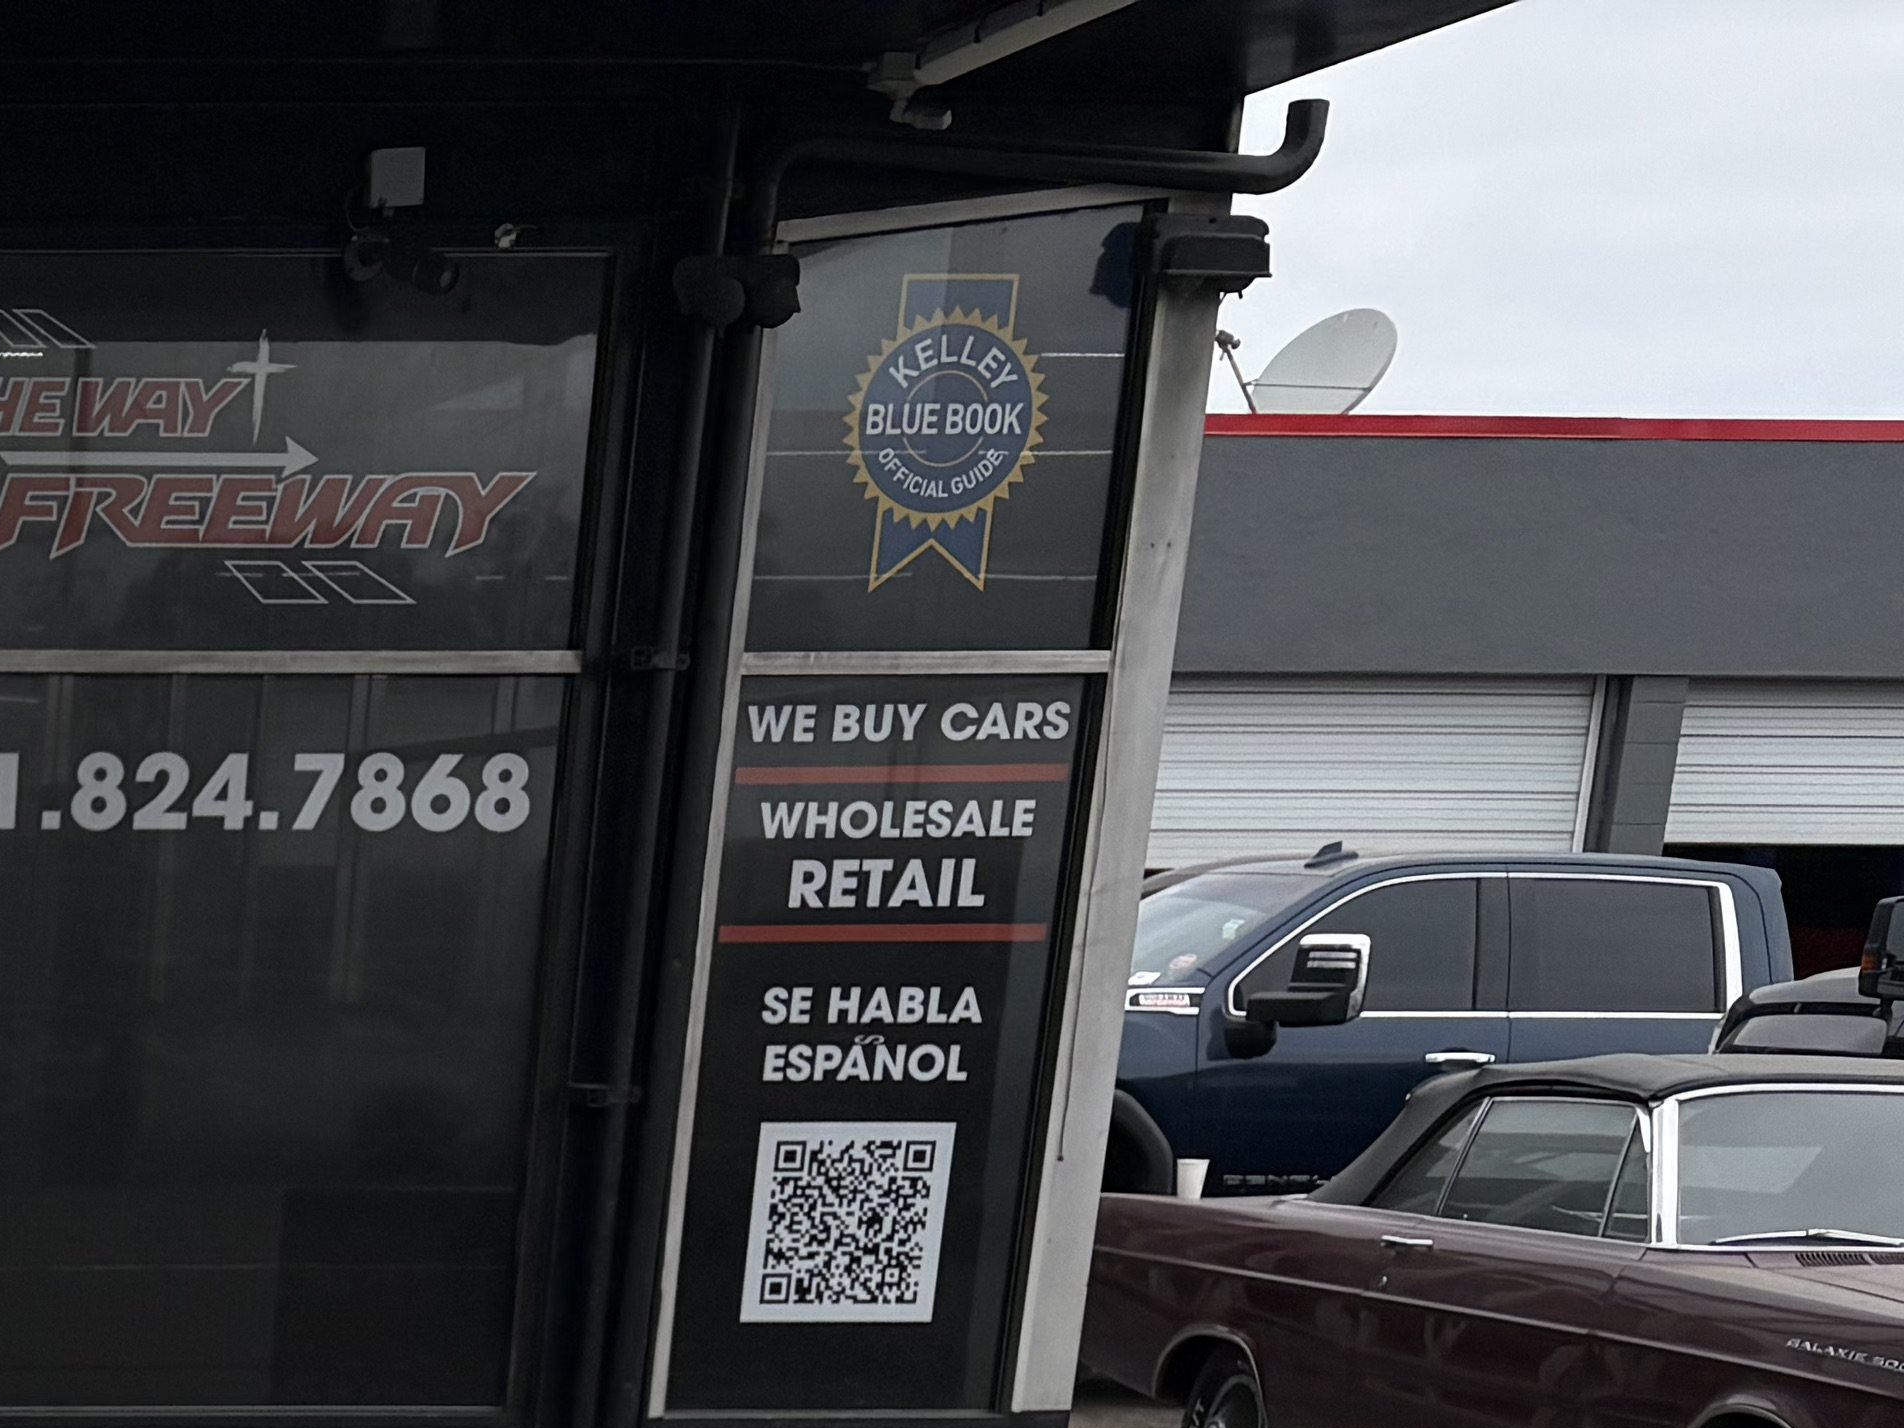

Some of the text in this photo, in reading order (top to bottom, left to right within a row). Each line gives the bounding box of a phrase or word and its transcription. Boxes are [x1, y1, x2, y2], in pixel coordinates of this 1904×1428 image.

[889, 334, 1018, 388] KELLEY
[73, 378, 250, 438] WAY
[866, 403, 1024, 435] BLUE BOOK
[878, 447, 1005, 498] OFFICIAL GUIDE
[748, 701, 1071, 743] WE BUY CARS
[760, 799, 1036, 839] WHOLESALE
[788, 858, 985, 909] RETAIL
[761, 986, 983, 1025] SE HABLA
